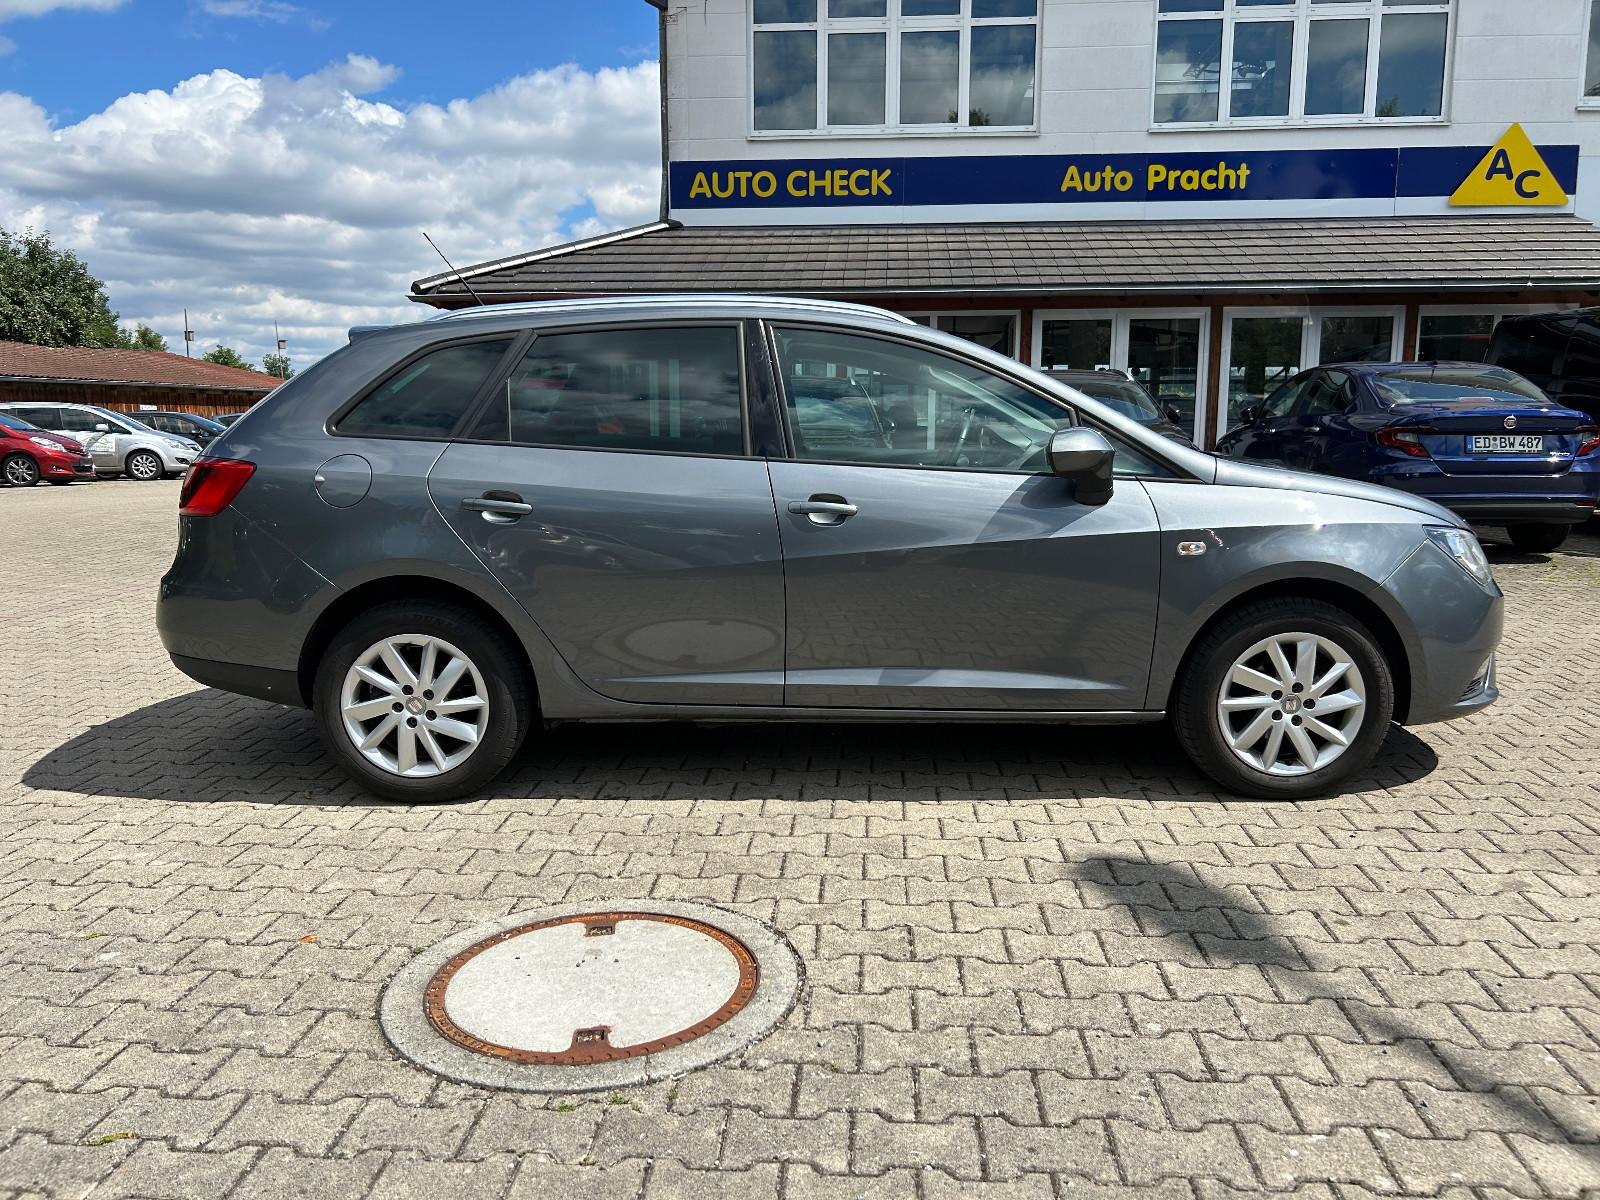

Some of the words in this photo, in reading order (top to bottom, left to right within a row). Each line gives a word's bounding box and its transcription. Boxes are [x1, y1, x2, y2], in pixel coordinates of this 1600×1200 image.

[689, 171, 777, 198] AUTO
[786, 169, 892, 197] CHECK
[1060, 165, 1133, 192] Auto
[1147, 161, 1250, 190] Pracht
[1518, 436, 1541, 449] 487
